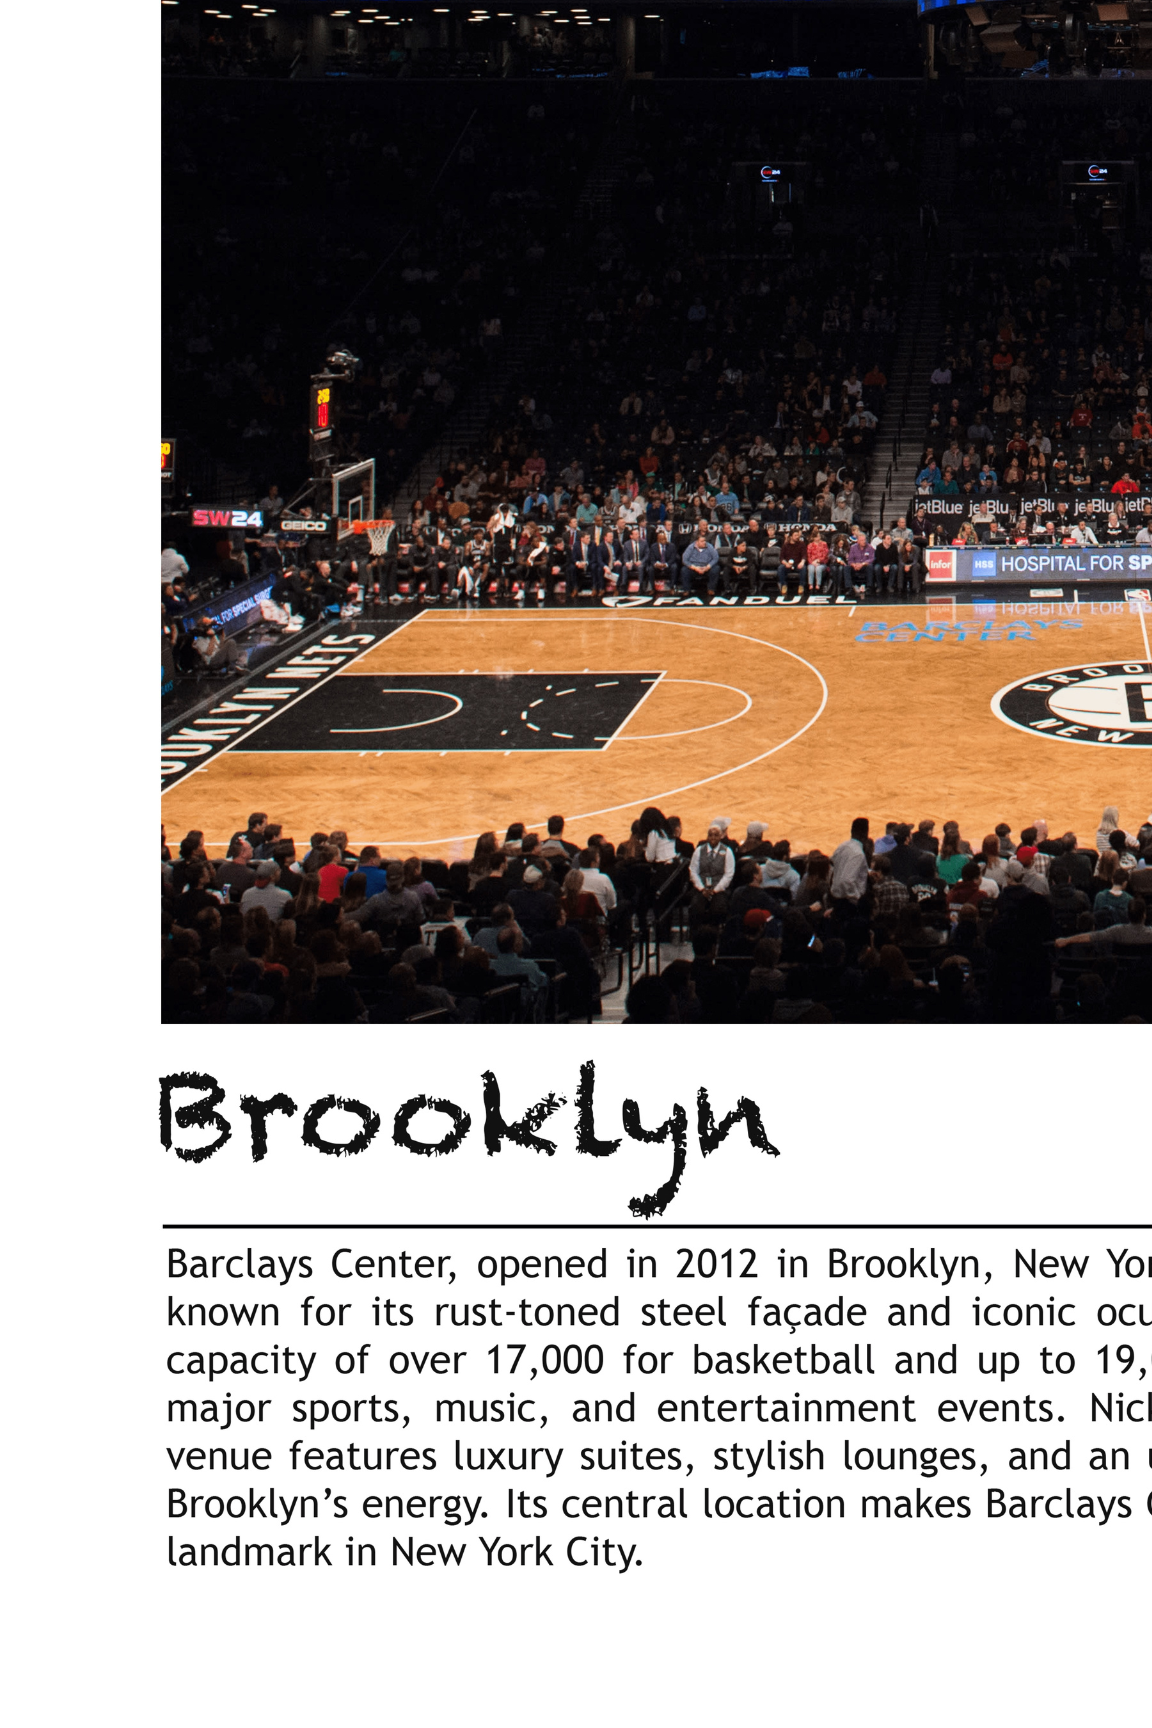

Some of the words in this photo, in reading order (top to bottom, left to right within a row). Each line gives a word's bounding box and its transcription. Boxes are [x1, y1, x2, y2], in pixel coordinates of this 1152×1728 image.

[914, 499, 963, 516] jetBlue
[193, 509, 264, 527] SW24
[281, 520, 326, 532] GEICO
[974, 560, 994, 569] HSS
[1002, 556, 1086, 572] HOSPITAL
[1091, 555, 1125, 571] FOR
[653, 595, 858, 606] FANDUEL
[861, 619, 1084, 632] BARCLAYS
[854, 631, 1037, 643] CENTER
[265, 634, 376, 679] NETS
[1029, 718, 1134, 743] NEW
